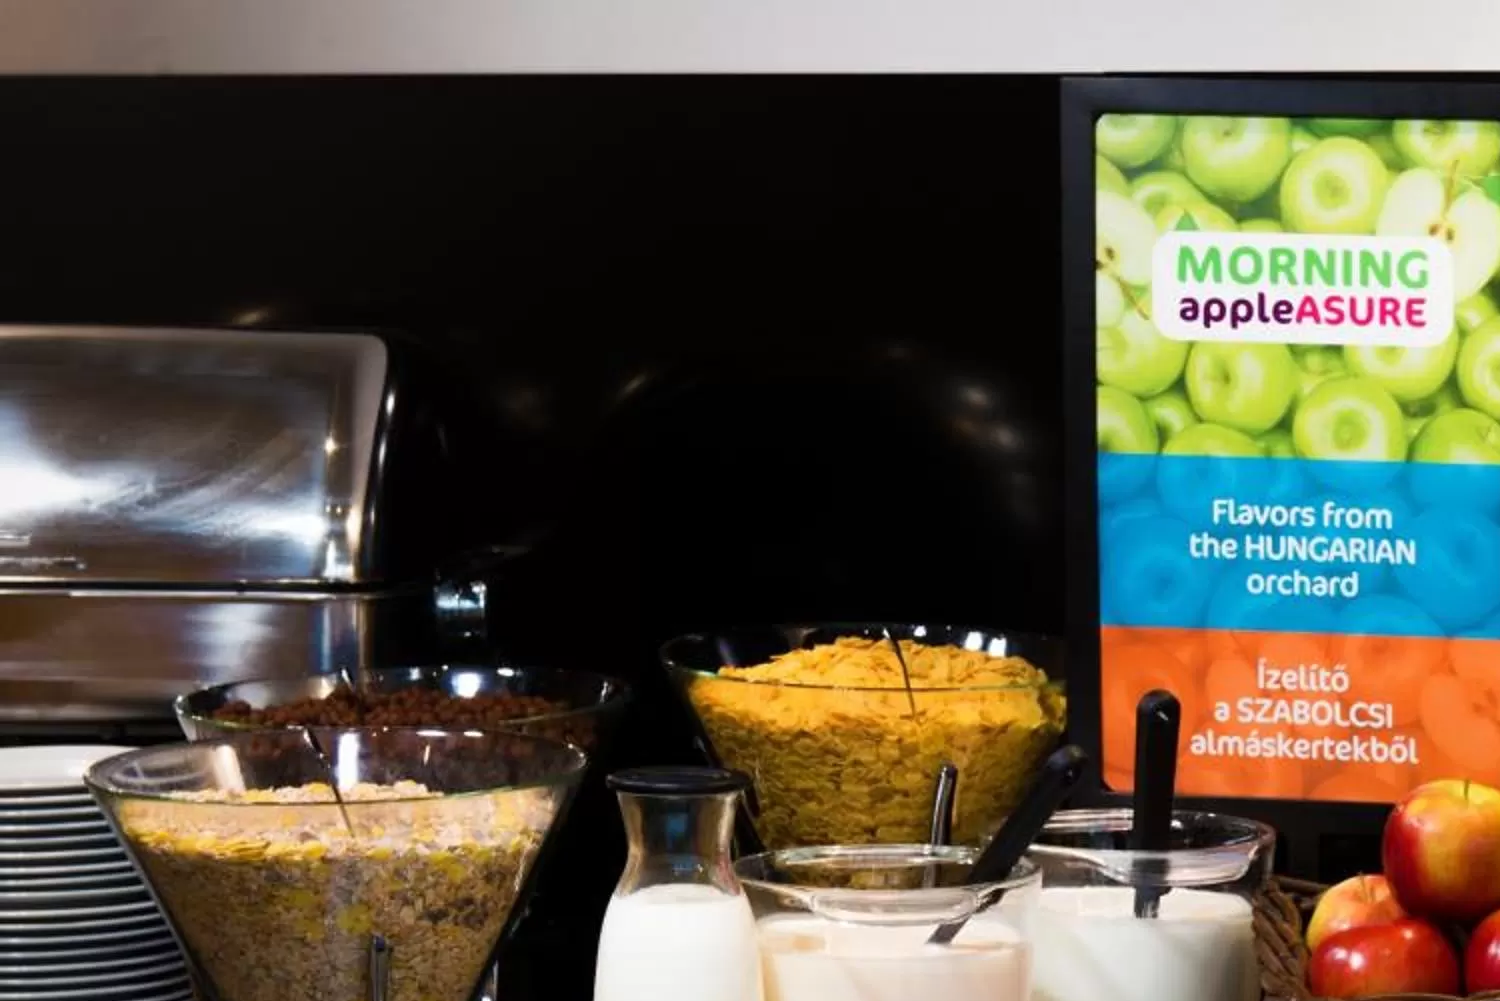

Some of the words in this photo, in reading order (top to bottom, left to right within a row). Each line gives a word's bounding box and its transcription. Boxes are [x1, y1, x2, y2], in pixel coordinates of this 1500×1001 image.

[1176, 244, 1429, 289] MORNING
[1178, 292, 1427, 329] appleASURE
[1212, 498, 1317, 528] Flavors
[1322, 501, 1394, 530] from
[1189, 532, 1238, 560] the
[1244, 534, 1417, 565] HUNGARIAN
[1246, 569, 1360, 598] orchard
[1256, 657, 1350, 693] Ízelítő
[1213, 702, 1231, 722] a
[1237, 698, 1394, 729] SZABOLCSI
[1190, 729, 1420, 765] almáskertekből
